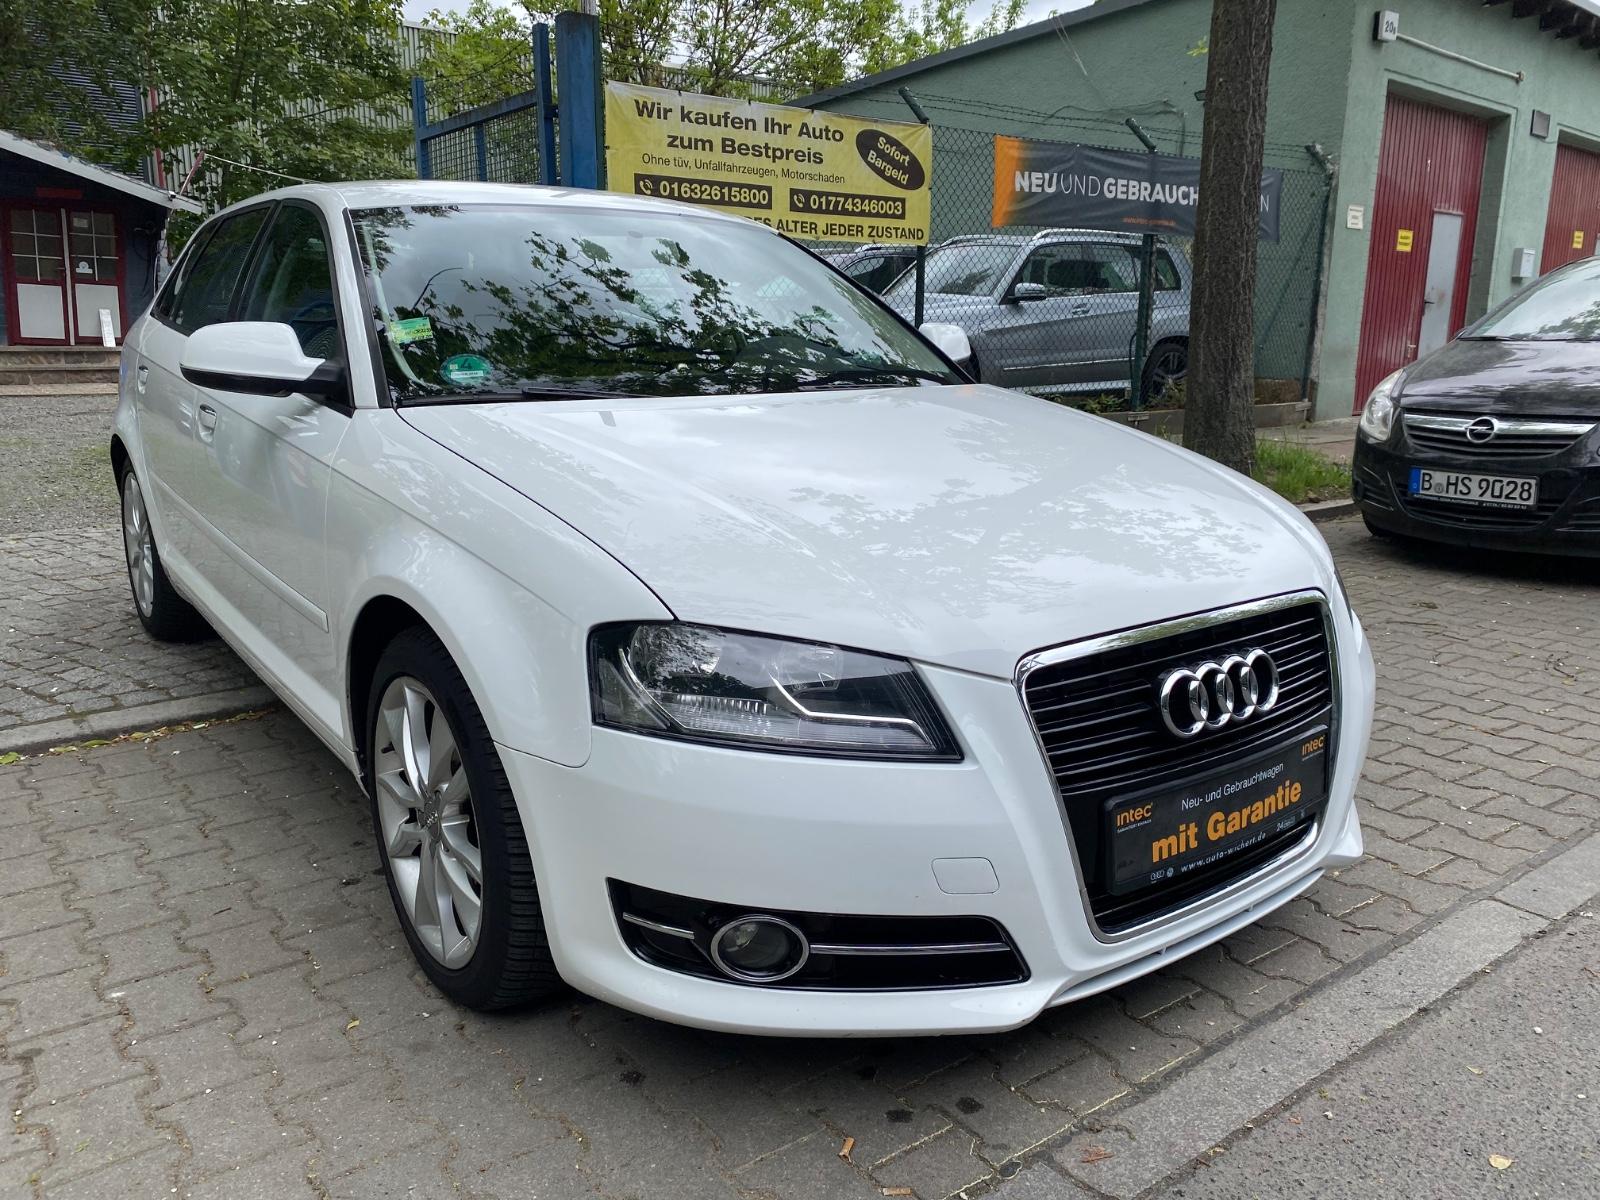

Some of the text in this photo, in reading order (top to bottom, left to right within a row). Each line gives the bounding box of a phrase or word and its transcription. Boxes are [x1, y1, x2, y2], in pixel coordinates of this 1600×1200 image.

[634, 99, 844, 143] Wir kaufen Ihr Auto
[666, 134, 824, 165] zum Bestpreis
[877, 136, 910, 167] Sofort
[641, 152, 845, 184] Ohne tüv, Unfallfahrzeugen, Motorschaden
[867, 149, 909, 185] Bargeld
[659, 180, 769, 205] 01632615800
[1014, 171, 1057, 193] NEU
[1060, 174, 1101, 197] UND
[810, 194, 903, 215] 01774346003
[776, 218, 818, 235] ALTER
[822, 222, 864, 238] JEDER
[867, 225, 924, 240] ZUSTAND
[1421, 472, 1433, 491] B
[1446, 475, 1472, 496] HS
[1478, 478, 1533, 501] 9028
[1181, 763, 1284, 812] Neu- und Gebrauchtwagen
[1152, 779, 1302, 863] mit Garantie
